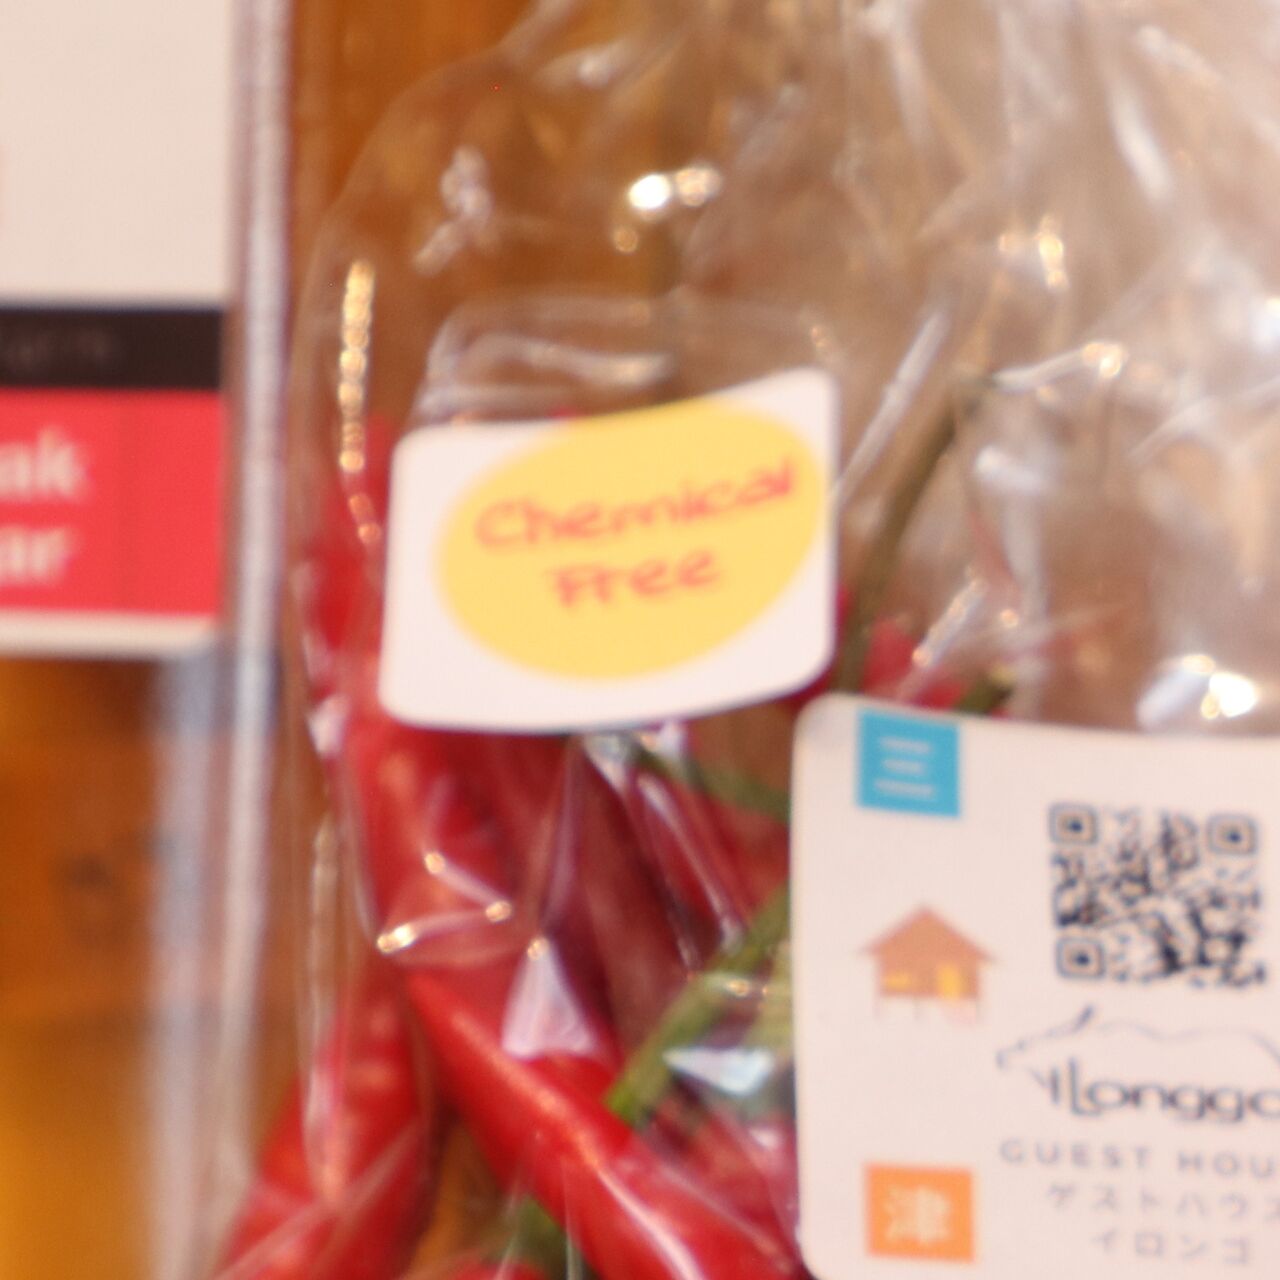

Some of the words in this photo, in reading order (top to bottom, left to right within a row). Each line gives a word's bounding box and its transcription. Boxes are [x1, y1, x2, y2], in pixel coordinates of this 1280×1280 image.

[474, 454, 798, 551] Chemical
[546, 545, 722, 608] Free
[998, 1137, 1153, 1168] GUEST
